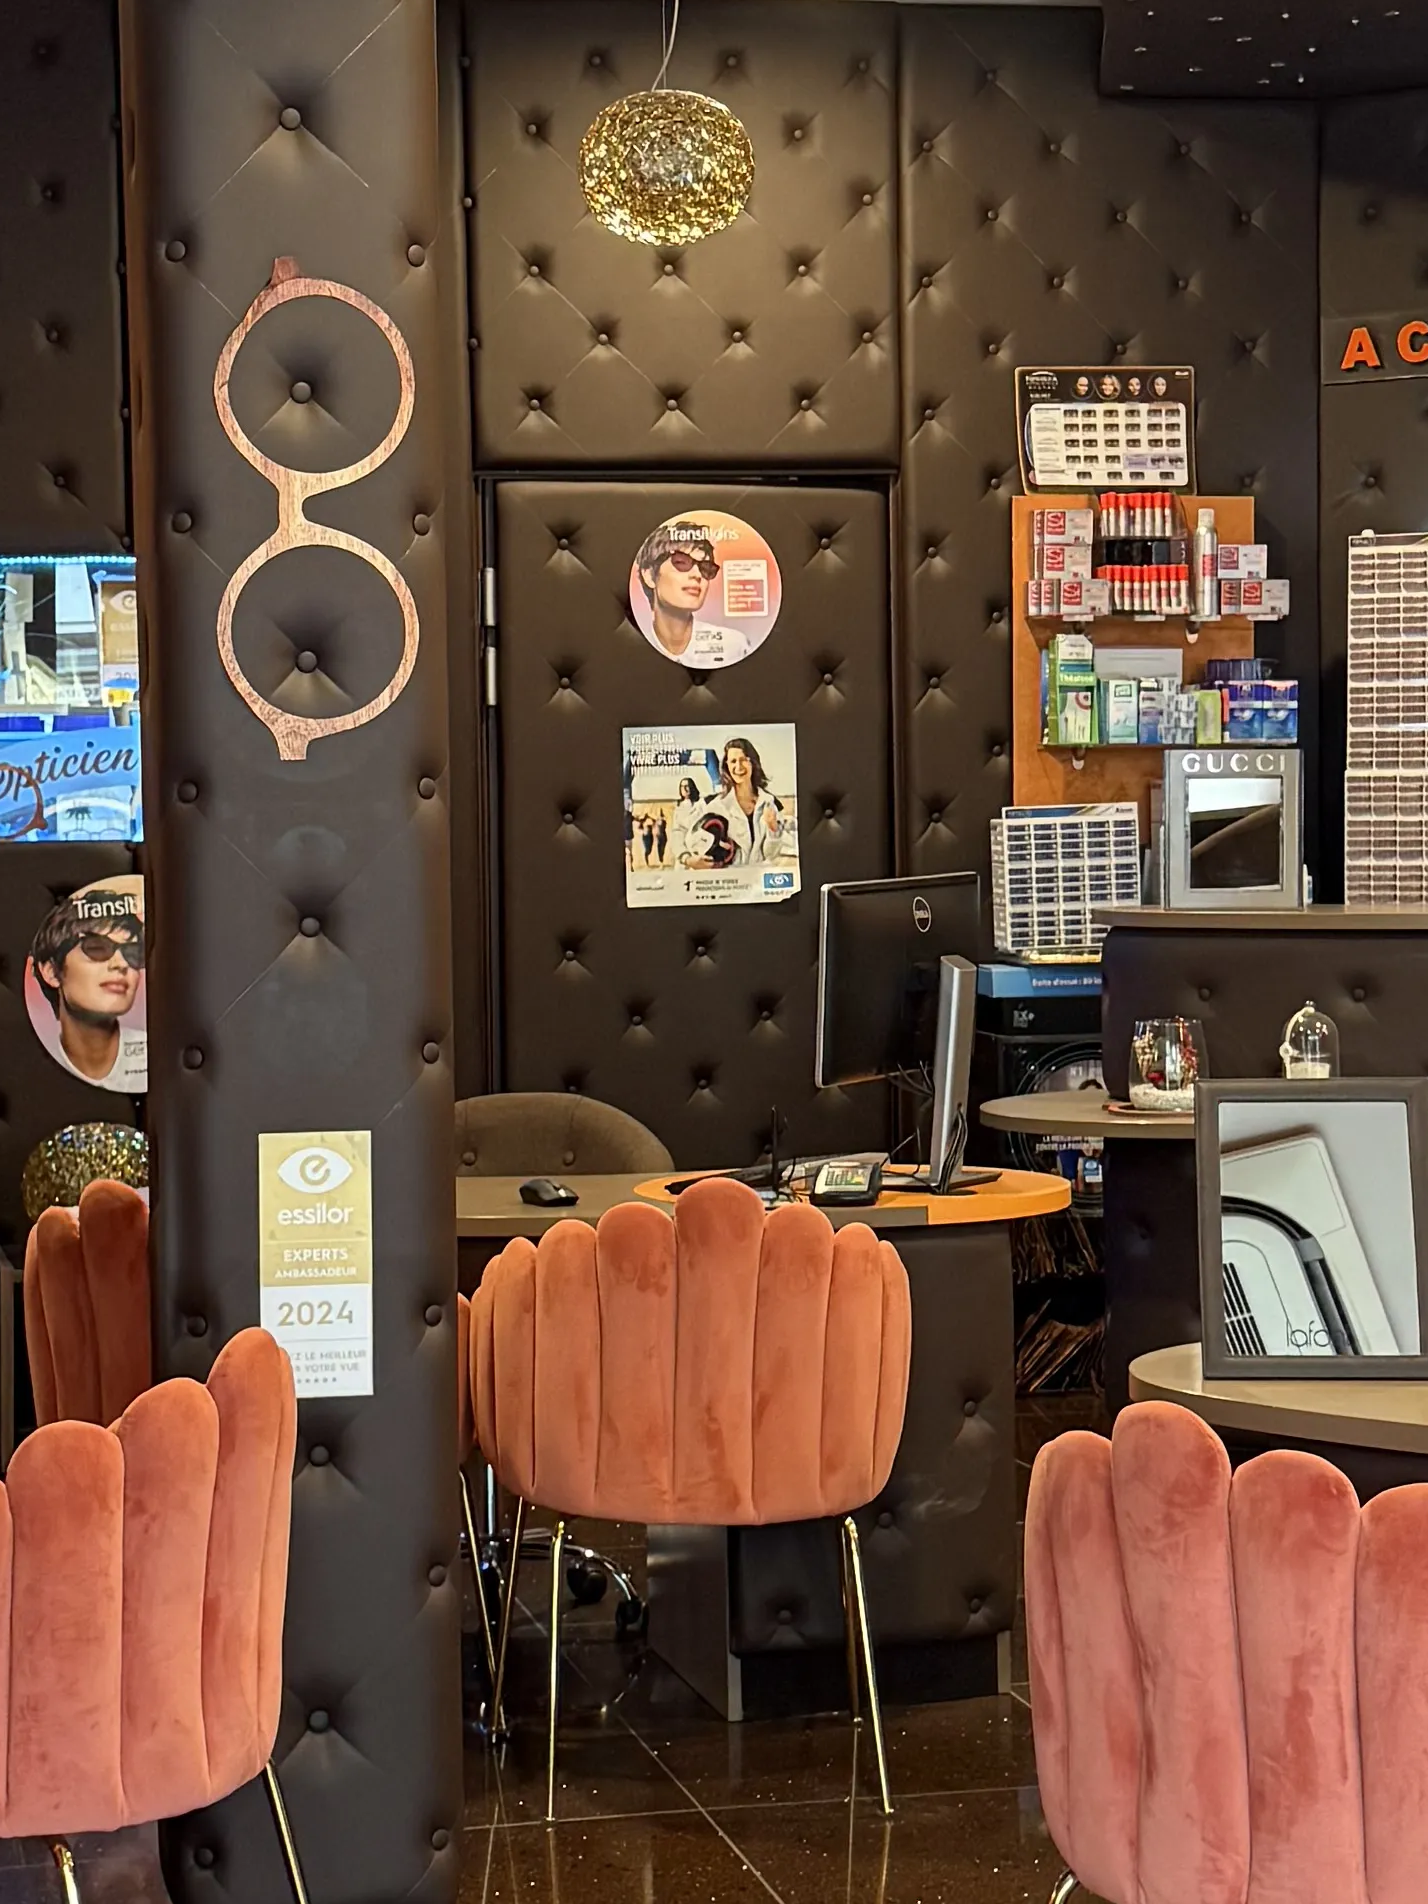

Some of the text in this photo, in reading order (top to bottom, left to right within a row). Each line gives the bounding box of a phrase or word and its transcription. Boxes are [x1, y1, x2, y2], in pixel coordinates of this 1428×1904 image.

[1181, 752, 1286, 773] GUCCI
[277, 1202, 354, 1226] essilor
[283, 1248, 349, 1262] EXPERTS
[275, 1267, 357, 1279] AMBASSADEUR
[277, 1299, 353, 1327] 2024
[304, 1352, 316, 1361] LE
[320, 1349, 367, 1360] MEILLEUR
[304, 1362, 336, 1372] VOTRE
[340, 1362, 360, 1371] VUE
